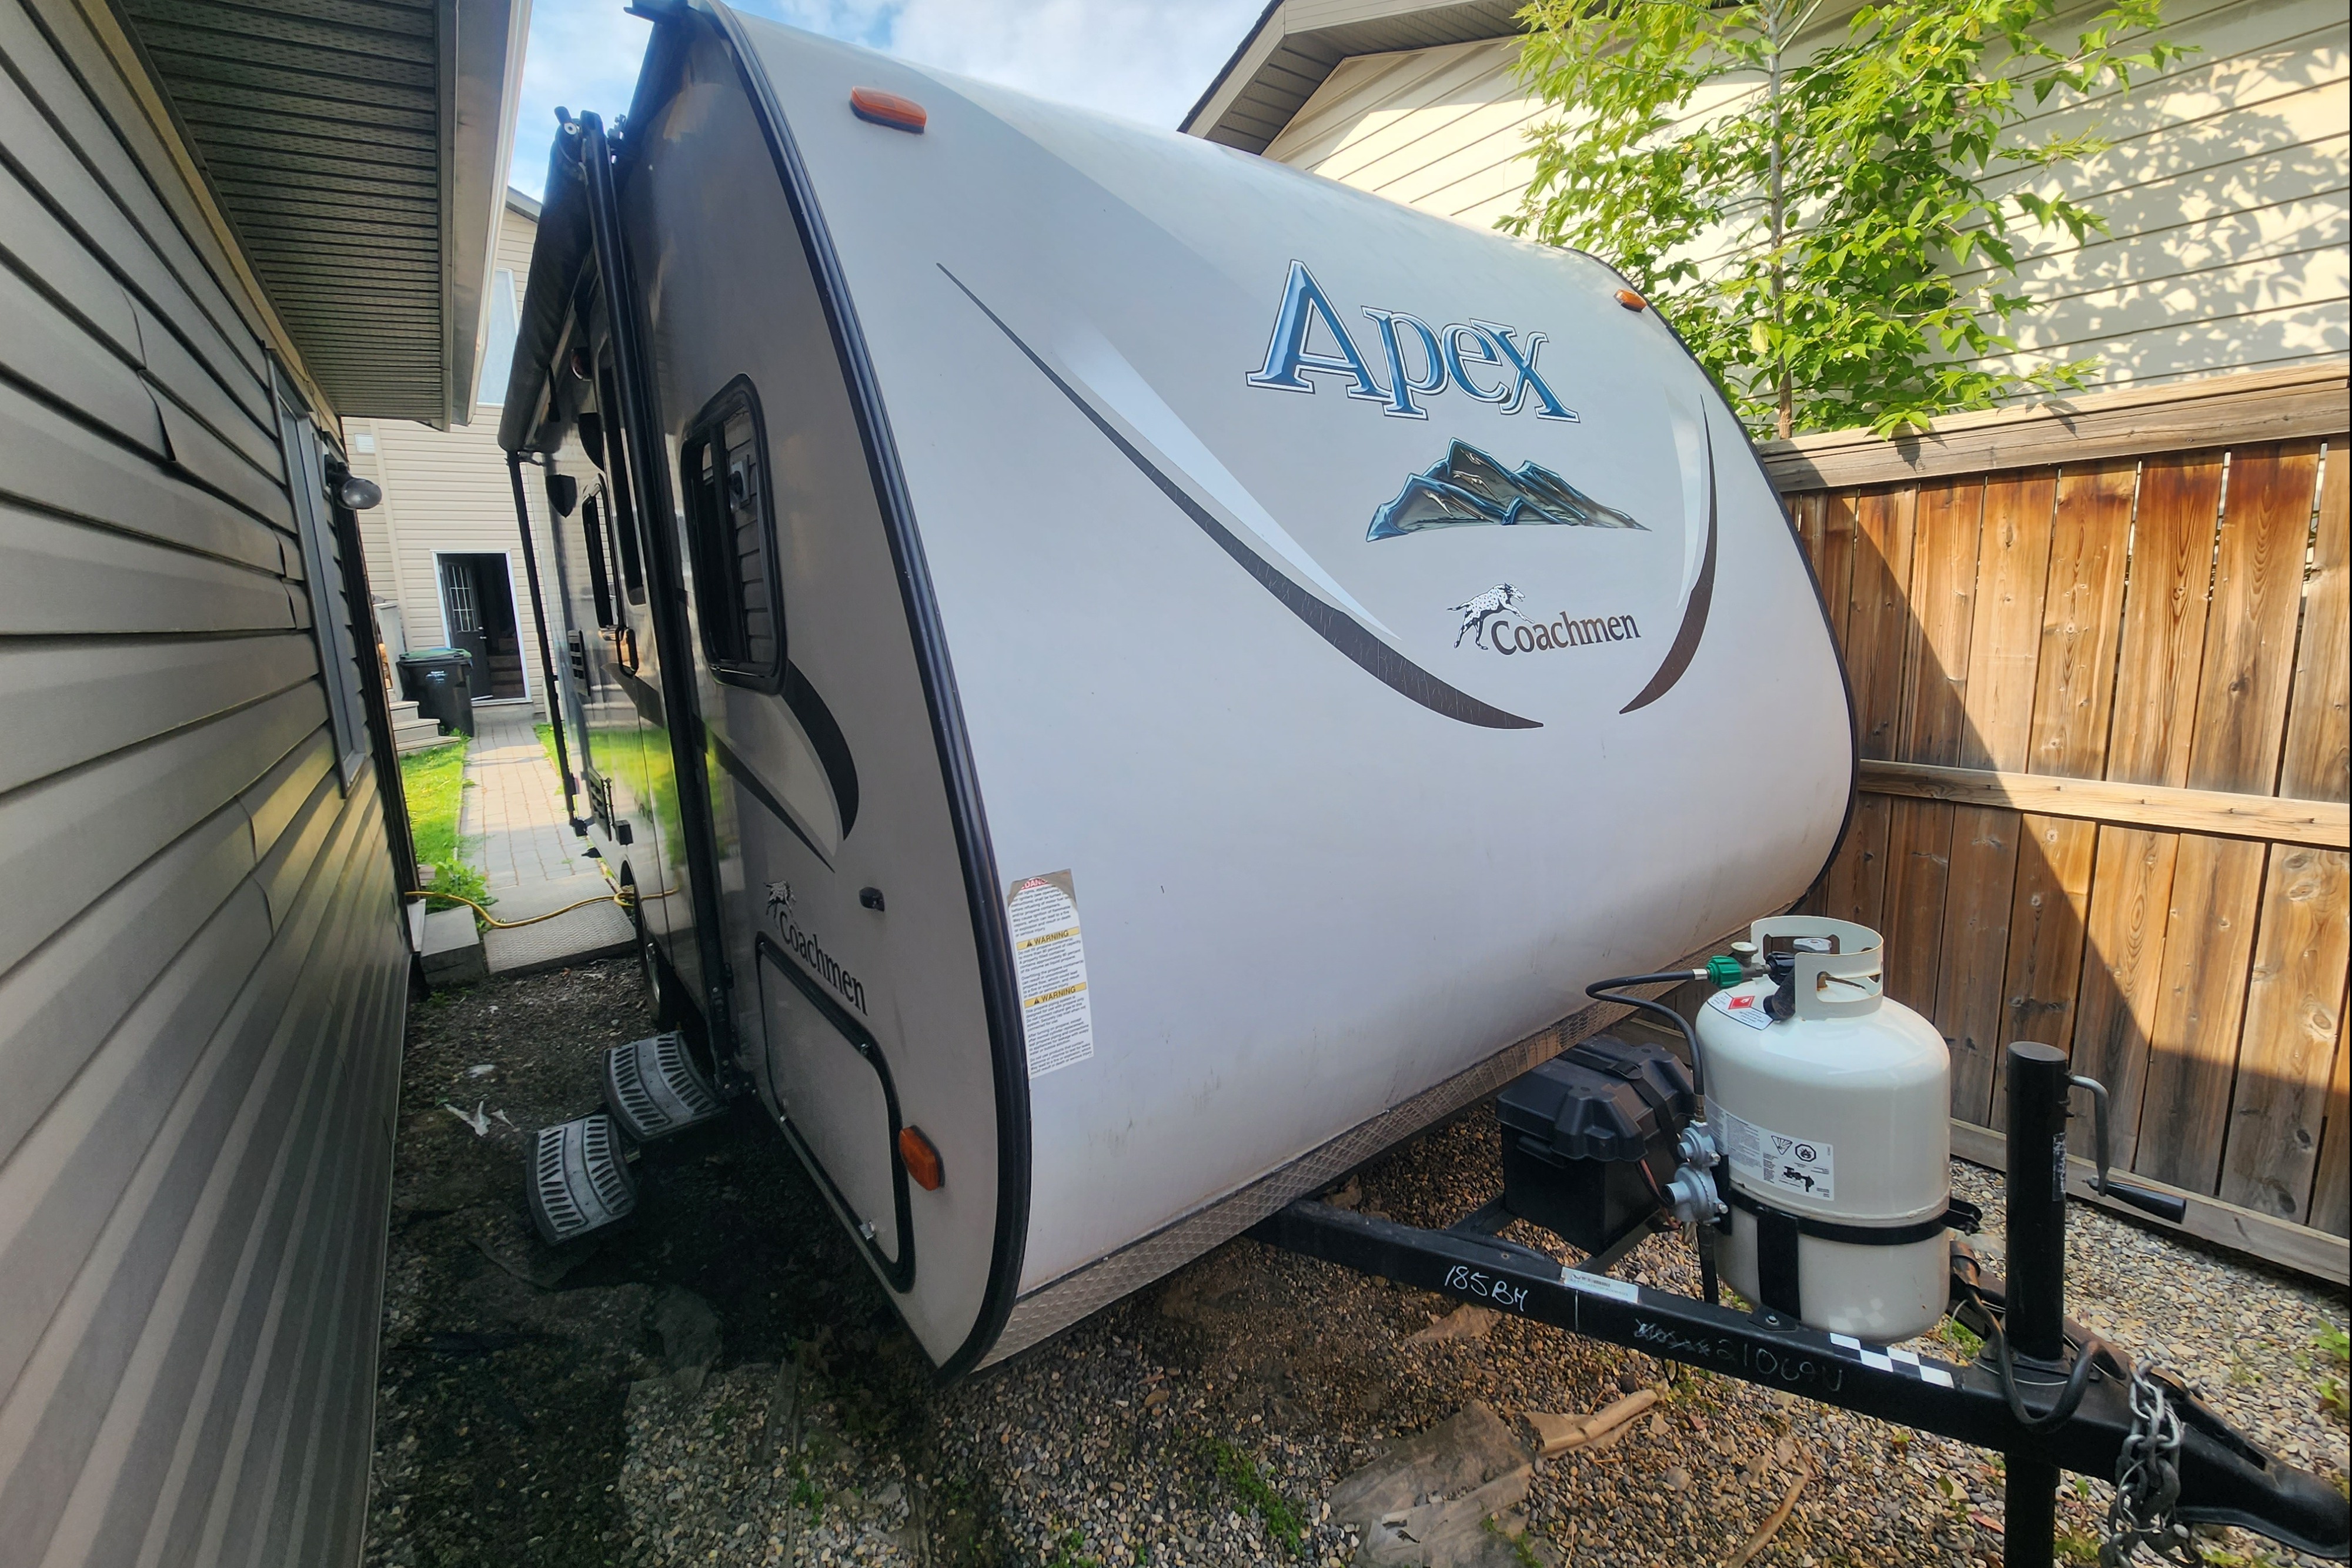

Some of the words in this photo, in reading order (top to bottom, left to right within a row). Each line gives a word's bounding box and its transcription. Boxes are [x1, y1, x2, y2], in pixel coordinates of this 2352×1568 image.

[1245, 259, 1581, 423] Apex
[1491, 611, 1642, 655] Coachmen
[1025, 878, 1047, 888] DANG
[1034, 930, 1069, 945] WARNING
[780, 911, 868, 1016] Coachmen
[1041, 985, 1075, 1002] WARNING
[1444, 1265, 1528, 1312] 185BH
